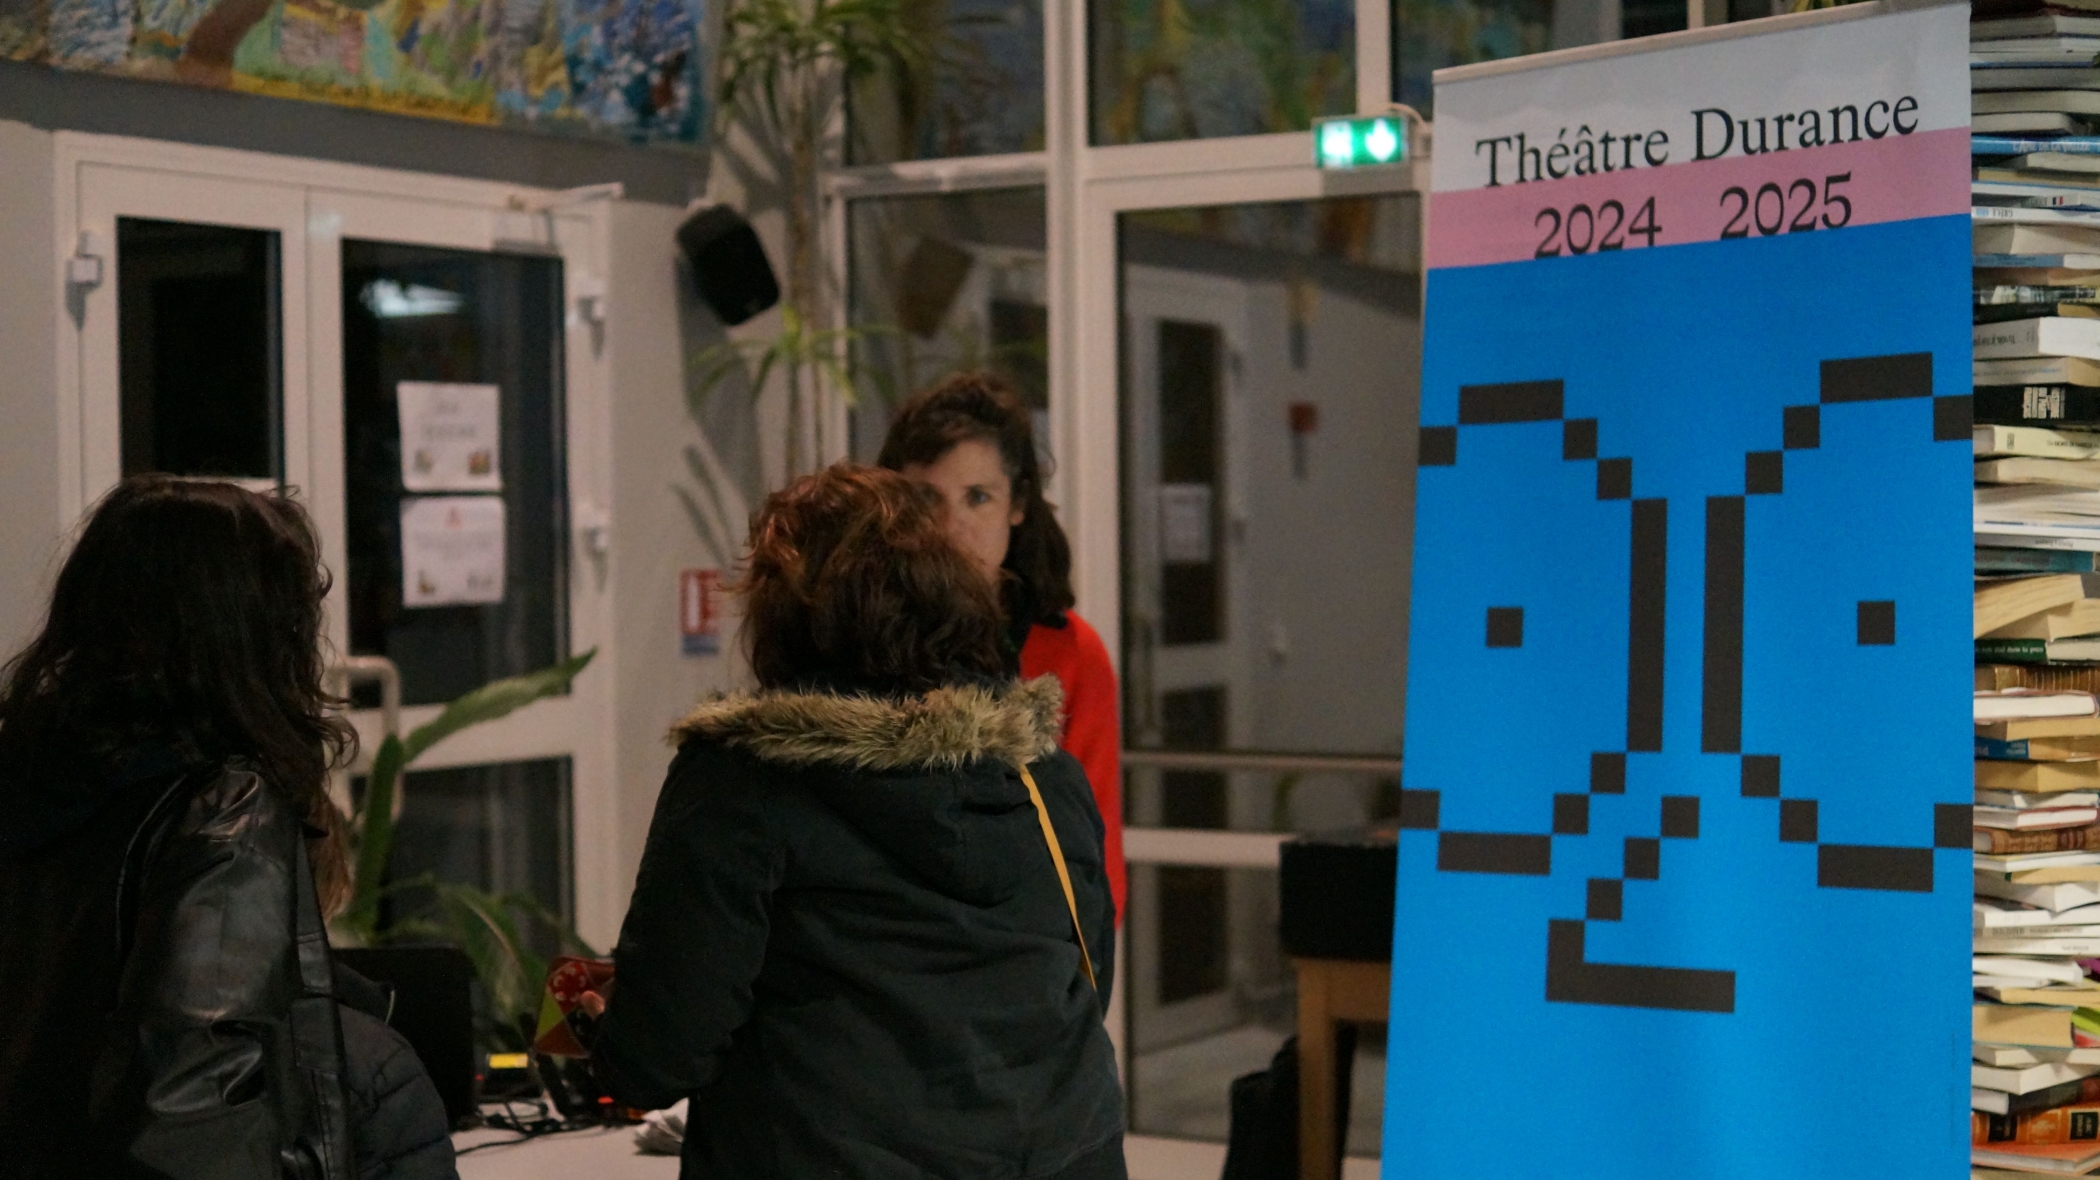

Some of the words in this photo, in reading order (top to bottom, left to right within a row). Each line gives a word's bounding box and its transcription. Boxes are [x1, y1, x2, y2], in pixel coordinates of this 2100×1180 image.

[1475, 124, 1670, 187] Théâtre
[1690, 95, 1919, 163] Durance
[1534, 196, 1663, 260] 2024
[1719, 171, 1852, 241] 2025
